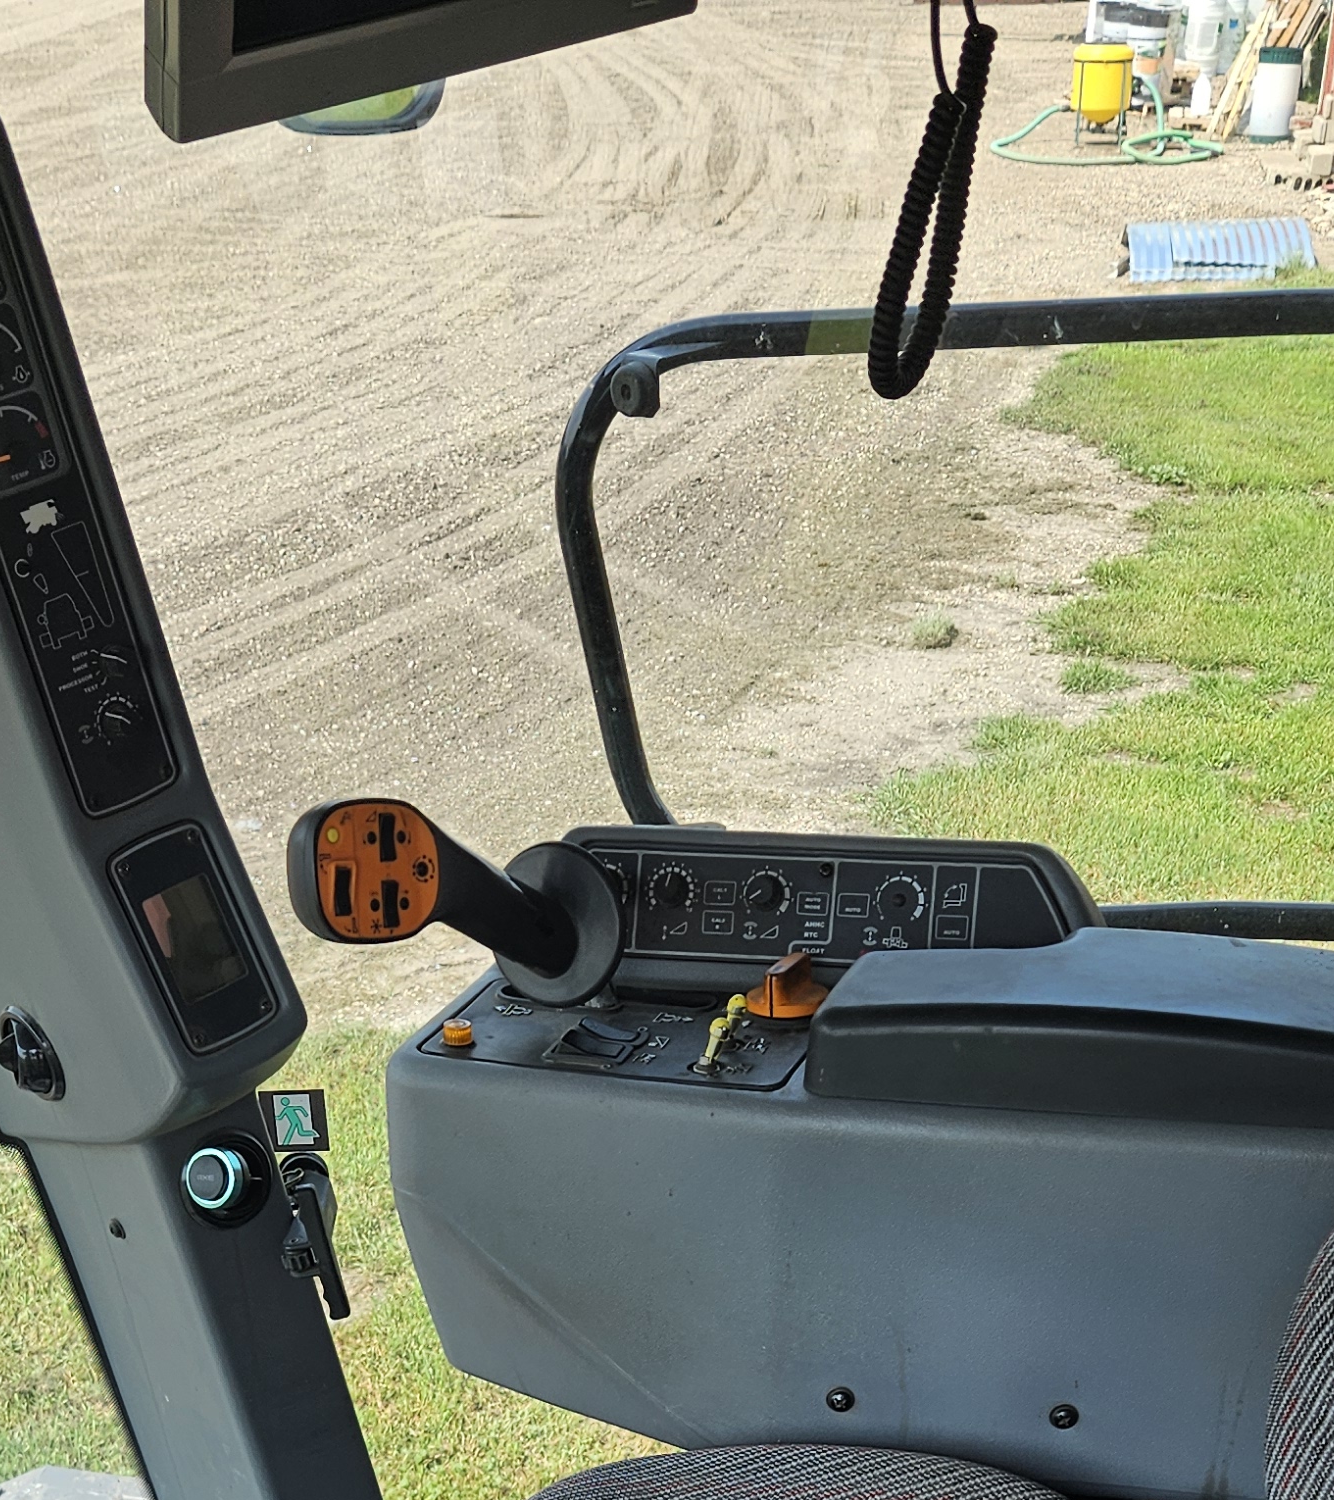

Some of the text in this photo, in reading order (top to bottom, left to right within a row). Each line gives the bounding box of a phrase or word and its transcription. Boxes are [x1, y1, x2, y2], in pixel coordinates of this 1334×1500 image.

[11, 470, 29, 481] TEMP
[71, 650, 88, 662] BOTH
[58, 673, 93, 692] PROCESSOR
[83, 683, 99, 694] TEST
[802, 947, 825, 955] FLOAT
